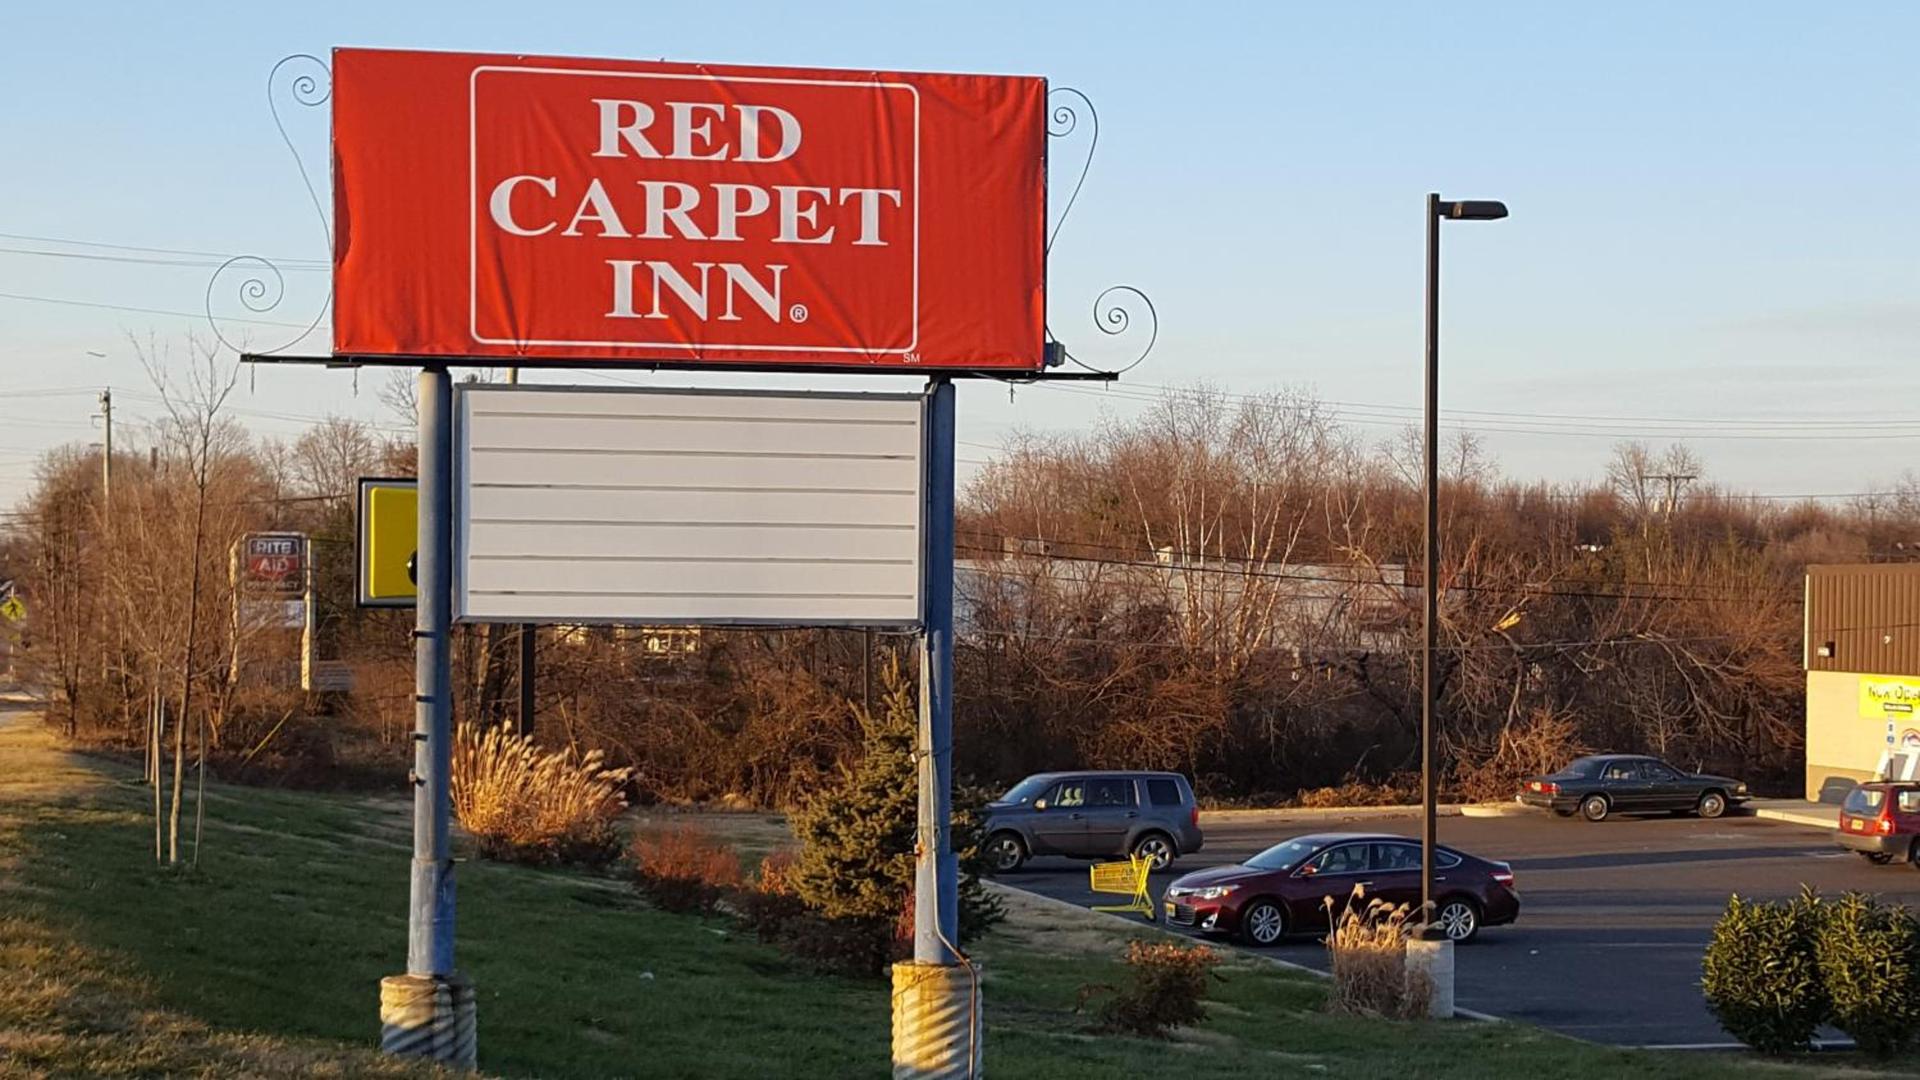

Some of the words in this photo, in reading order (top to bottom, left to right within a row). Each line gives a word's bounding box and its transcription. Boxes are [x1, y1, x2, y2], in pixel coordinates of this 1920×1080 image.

[592, 99, 802, 162] RED
[490, 176, 901, 246] CARPET
[605, 260, 788, 322] INN
[903, 353, 920, 363] SM
[256, 541, 292, 555] RITE
[259, 558, 289, 572] AID
